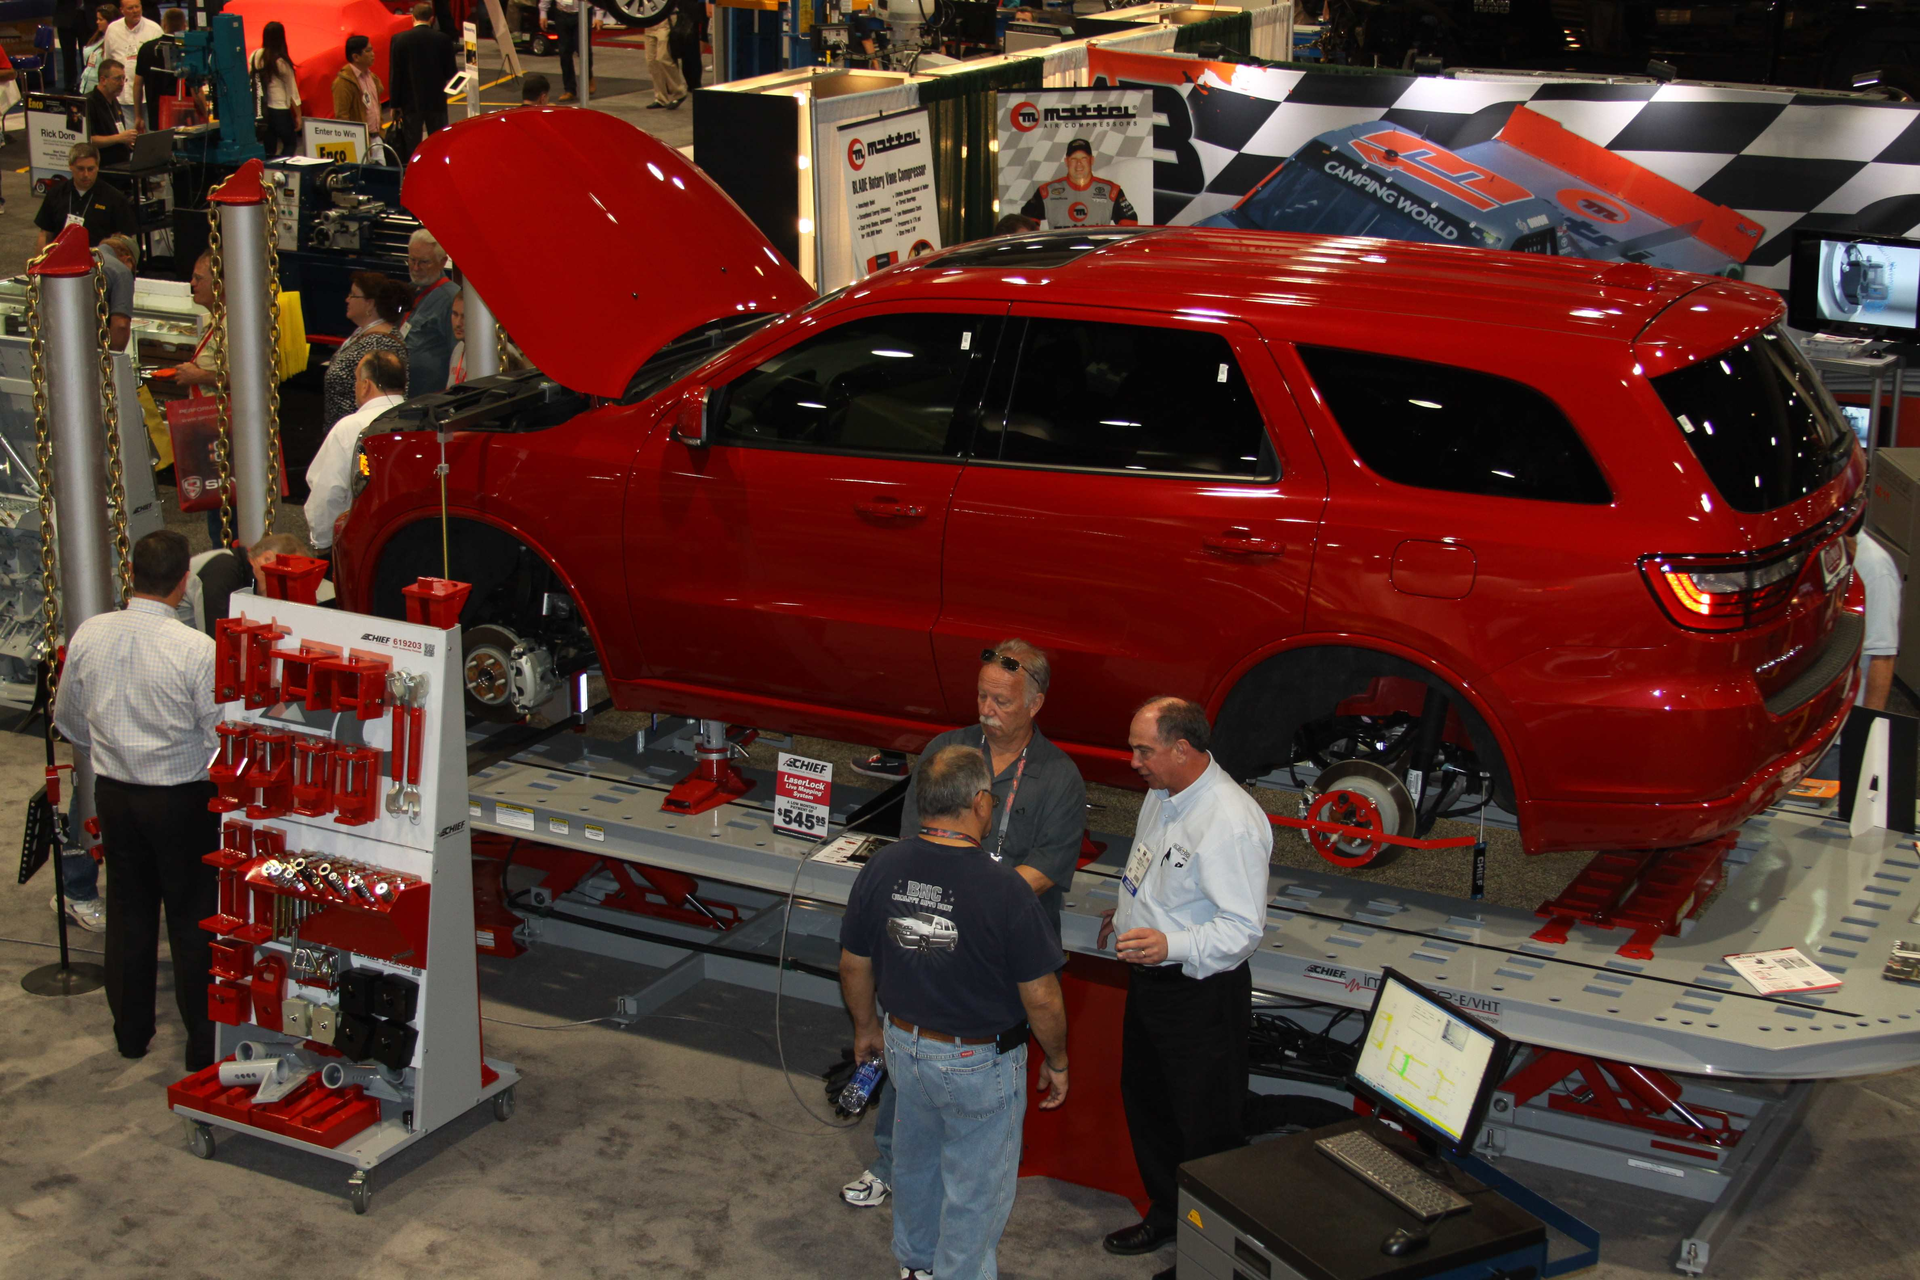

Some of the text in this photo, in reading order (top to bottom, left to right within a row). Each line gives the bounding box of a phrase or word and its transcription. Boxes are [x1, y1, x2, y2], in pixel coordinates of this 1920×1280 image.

[28, 98, 43, 110] Enco
[41, 128, 76, 141] Rick Dore
[314, 126, 333, 136] Enter
[343, 130, 357, 139] Win
[319, 146, 347, 164] Enco
[852, 164, 926, 194] BLADE Rotary Vane Compressor
[1324, 161, 1459, 240] CAMPING WORLD
[179, 403, 219, 414] PERFORMA
[365, 633, 391, 644] CHIEF
[393, 638, 422, 650] 619203
[790, 758, 828, 774] CHIEF
[784, 774, 826, 790] LaserLock
[785, 783, 823, 797] Live Mapping
[793, 790, 814, 800] System
[442, 820, 465, 836] CHIEF
[1476, 856, 1484, 886] CHIEF
[907, 880, 942, 902] BNC
[892, 893, 953, 912] QUALITY AUTO BODY
[1311, 964, 1346, 978] CHIEF
